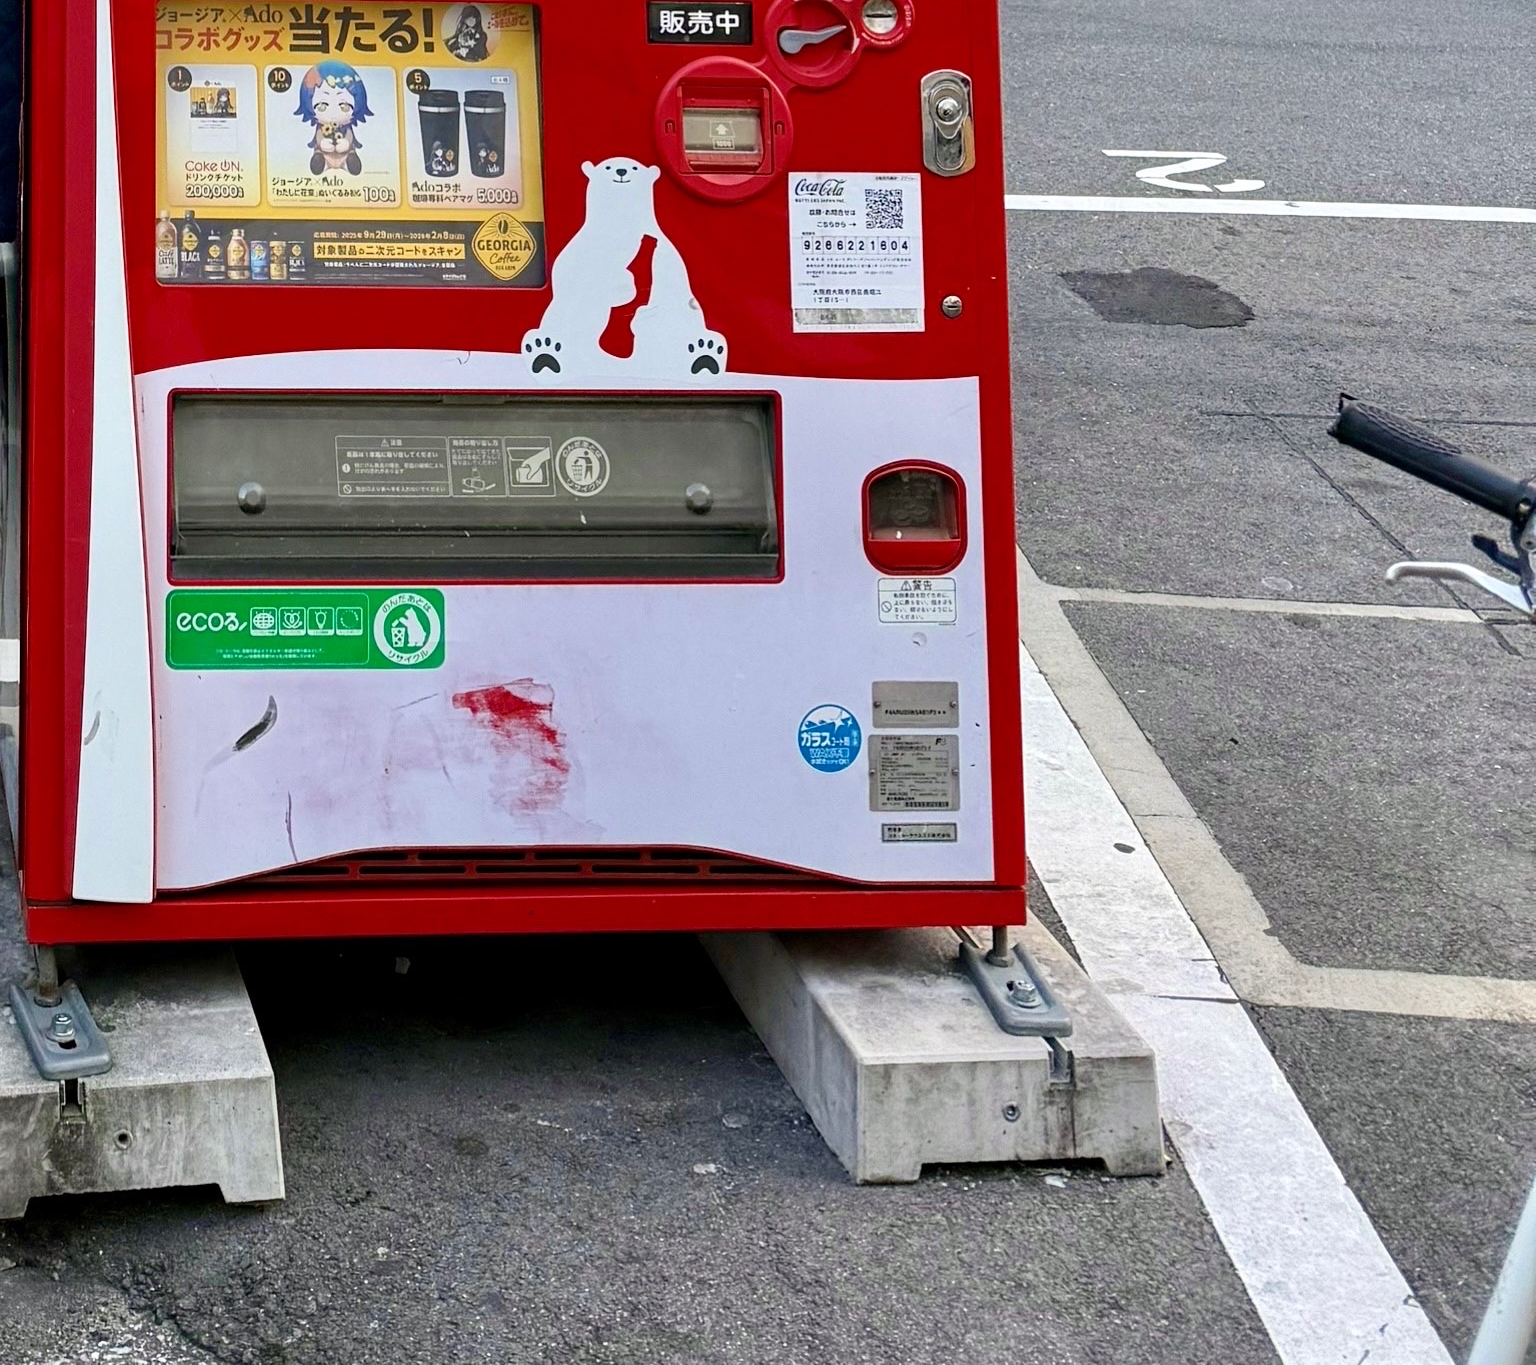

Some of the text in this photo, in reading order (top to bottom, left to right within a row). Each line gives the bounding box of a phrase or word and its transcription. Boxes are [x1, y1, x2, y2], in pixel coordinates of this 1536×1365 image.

[289, 4, 435, 54] 当たる!
[659, 9, 740, 36] 販売中
[273, 70, 285, 81] 10
[415, 73, 422, 83] 5
[185, 161, 218, 172] Coke
[795, 178, 847, 197] Coca-Cola
[477, 240, 532, 252] GEORGIA
[381, 594, 433, 614] のんだあとは
[387, 649, 430, 664] リサイクル
